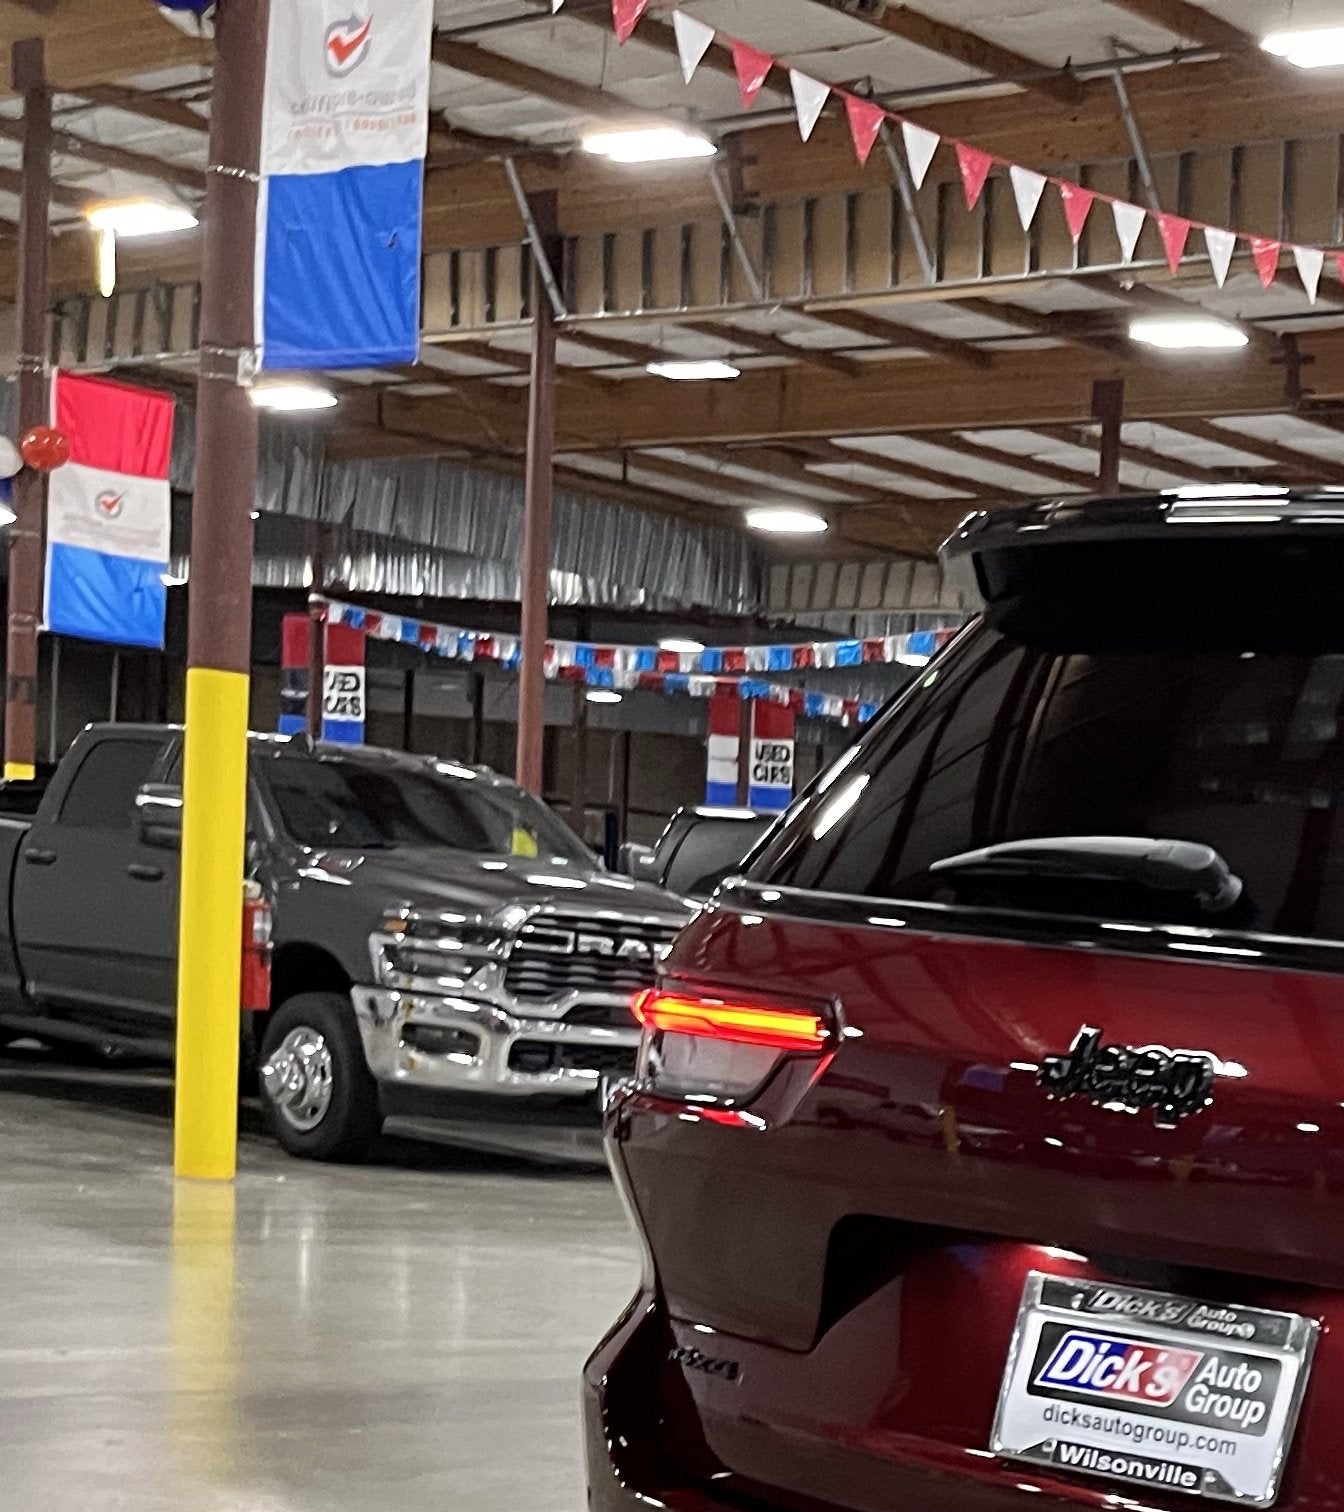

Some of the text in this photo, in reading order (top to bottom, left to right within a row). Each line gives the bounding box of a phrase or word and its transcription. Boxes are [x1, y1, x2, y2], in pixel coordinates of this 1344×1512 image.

[1197, 1304, 1237, 1322] Auto
[1046, 1339, 1262, 1397] Dick's Auto
[1184, 1383, 1266, 1428] Group
[1043, 1404, 1237, 1456] dicksautogroup.com
[1060, 1443, 1198, 1487] Wilsonville
